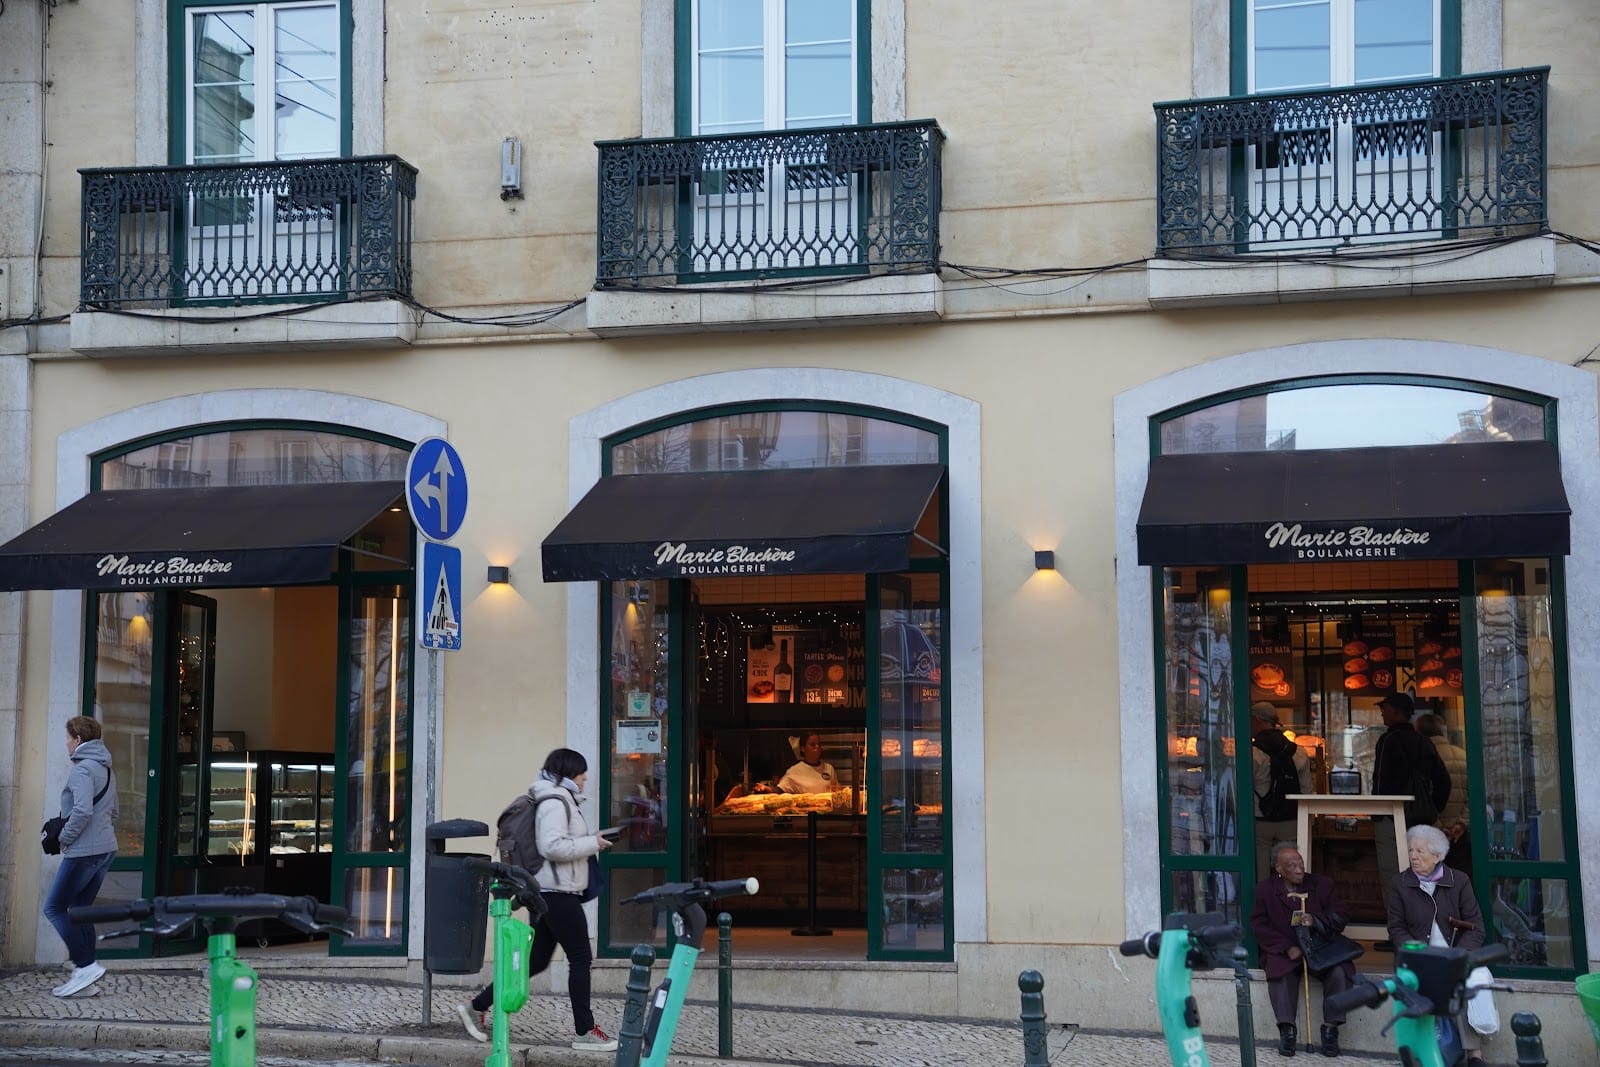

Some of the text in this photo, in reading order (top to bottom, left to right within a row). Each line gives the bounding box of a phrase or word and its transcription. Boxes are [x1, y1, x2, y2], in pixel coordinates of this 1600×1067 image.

[1264, 522, 1430, 548] Marie Blachère
[653, 541, 796, 565] Marie Blachère
[1298, 547, 1397, 559] BOULANGERIE
[96, 554, 232, 577] Marie Blachère
[681, 563, 766, 575] BOULANGERIE
[120, 574, 204, 585] BOULANGERIE
